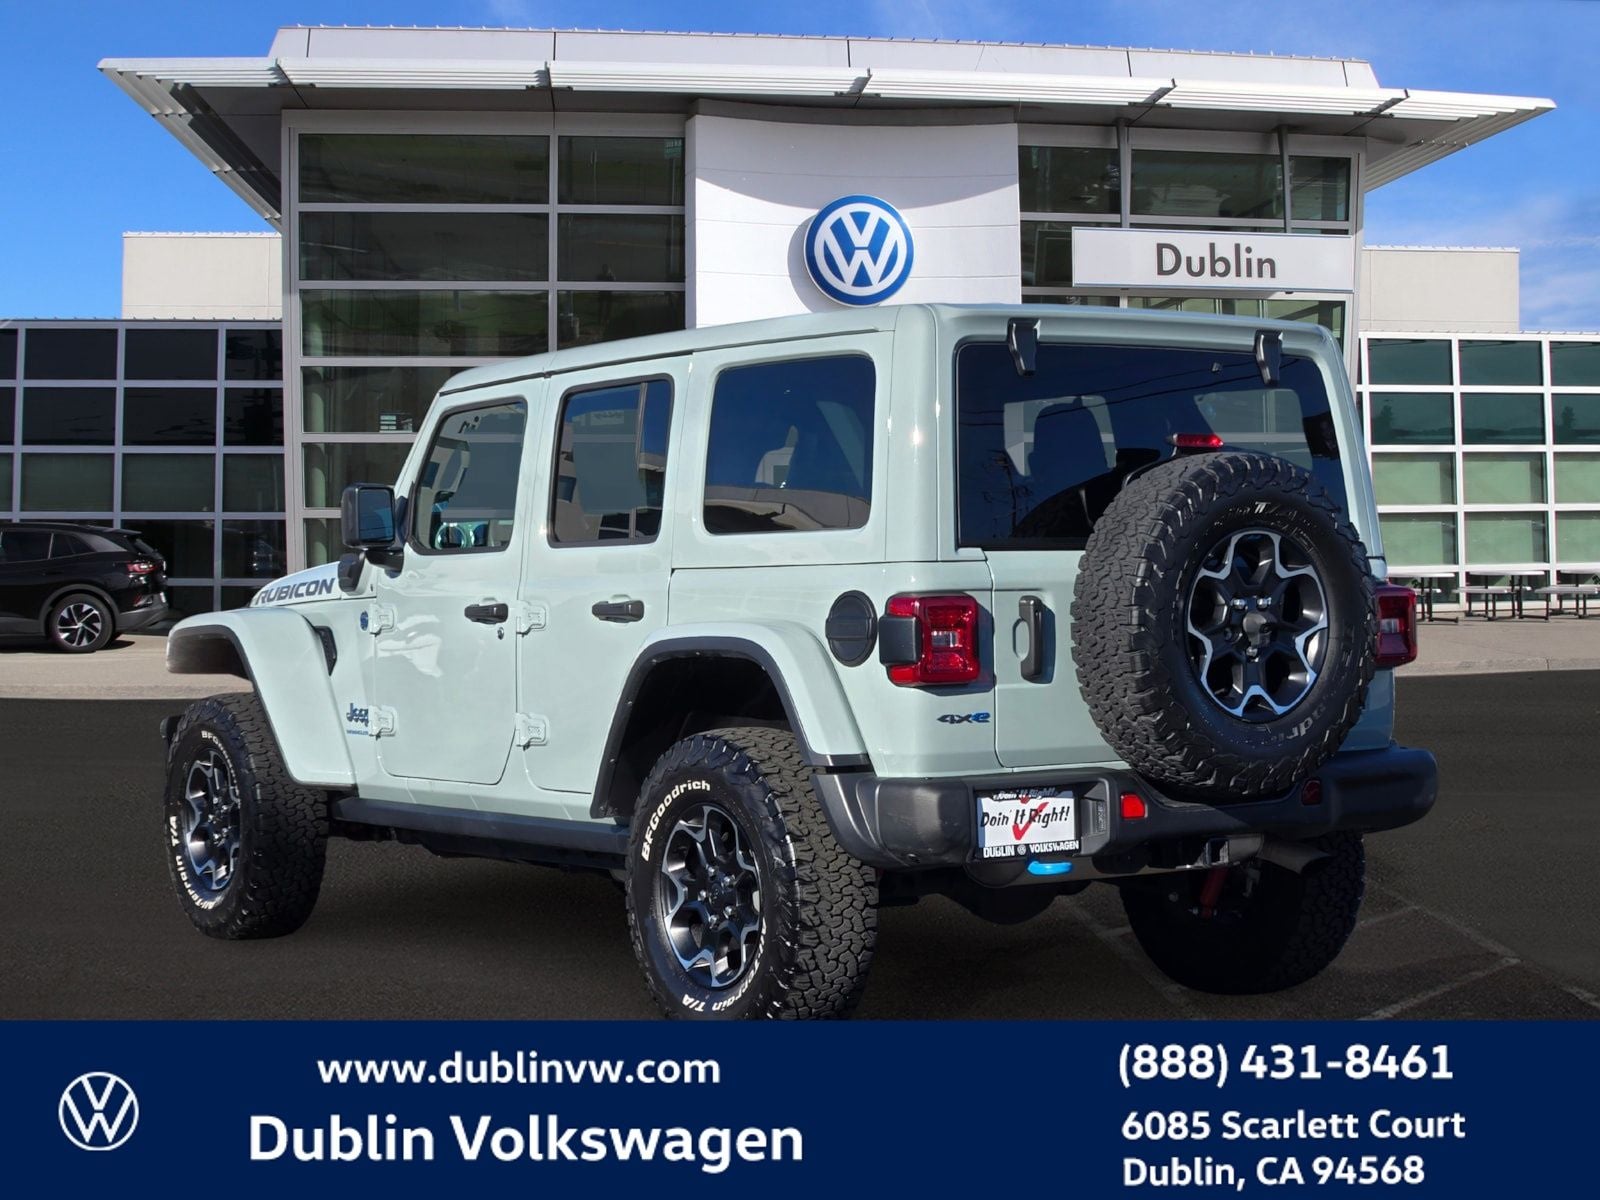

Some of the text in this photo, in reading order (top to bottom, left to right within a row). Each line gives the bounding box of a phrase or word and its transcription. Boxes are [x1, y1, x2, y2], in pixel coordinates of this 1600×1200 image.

[808, 199, 909, 302] VW
[1156, 242, 1277, 279] Dublin
[255, 578, 335, 604] RUBICON
[641, 780, 711, 862] BFGoodrich
[982, 806, 1070, 828] Doin' It Right!
[983, 845, 1016, 858] DUBLIN
[1029, 840, 1079, 854] VOLKSWAGEN
[682, 994, 706, 1012] T/A
